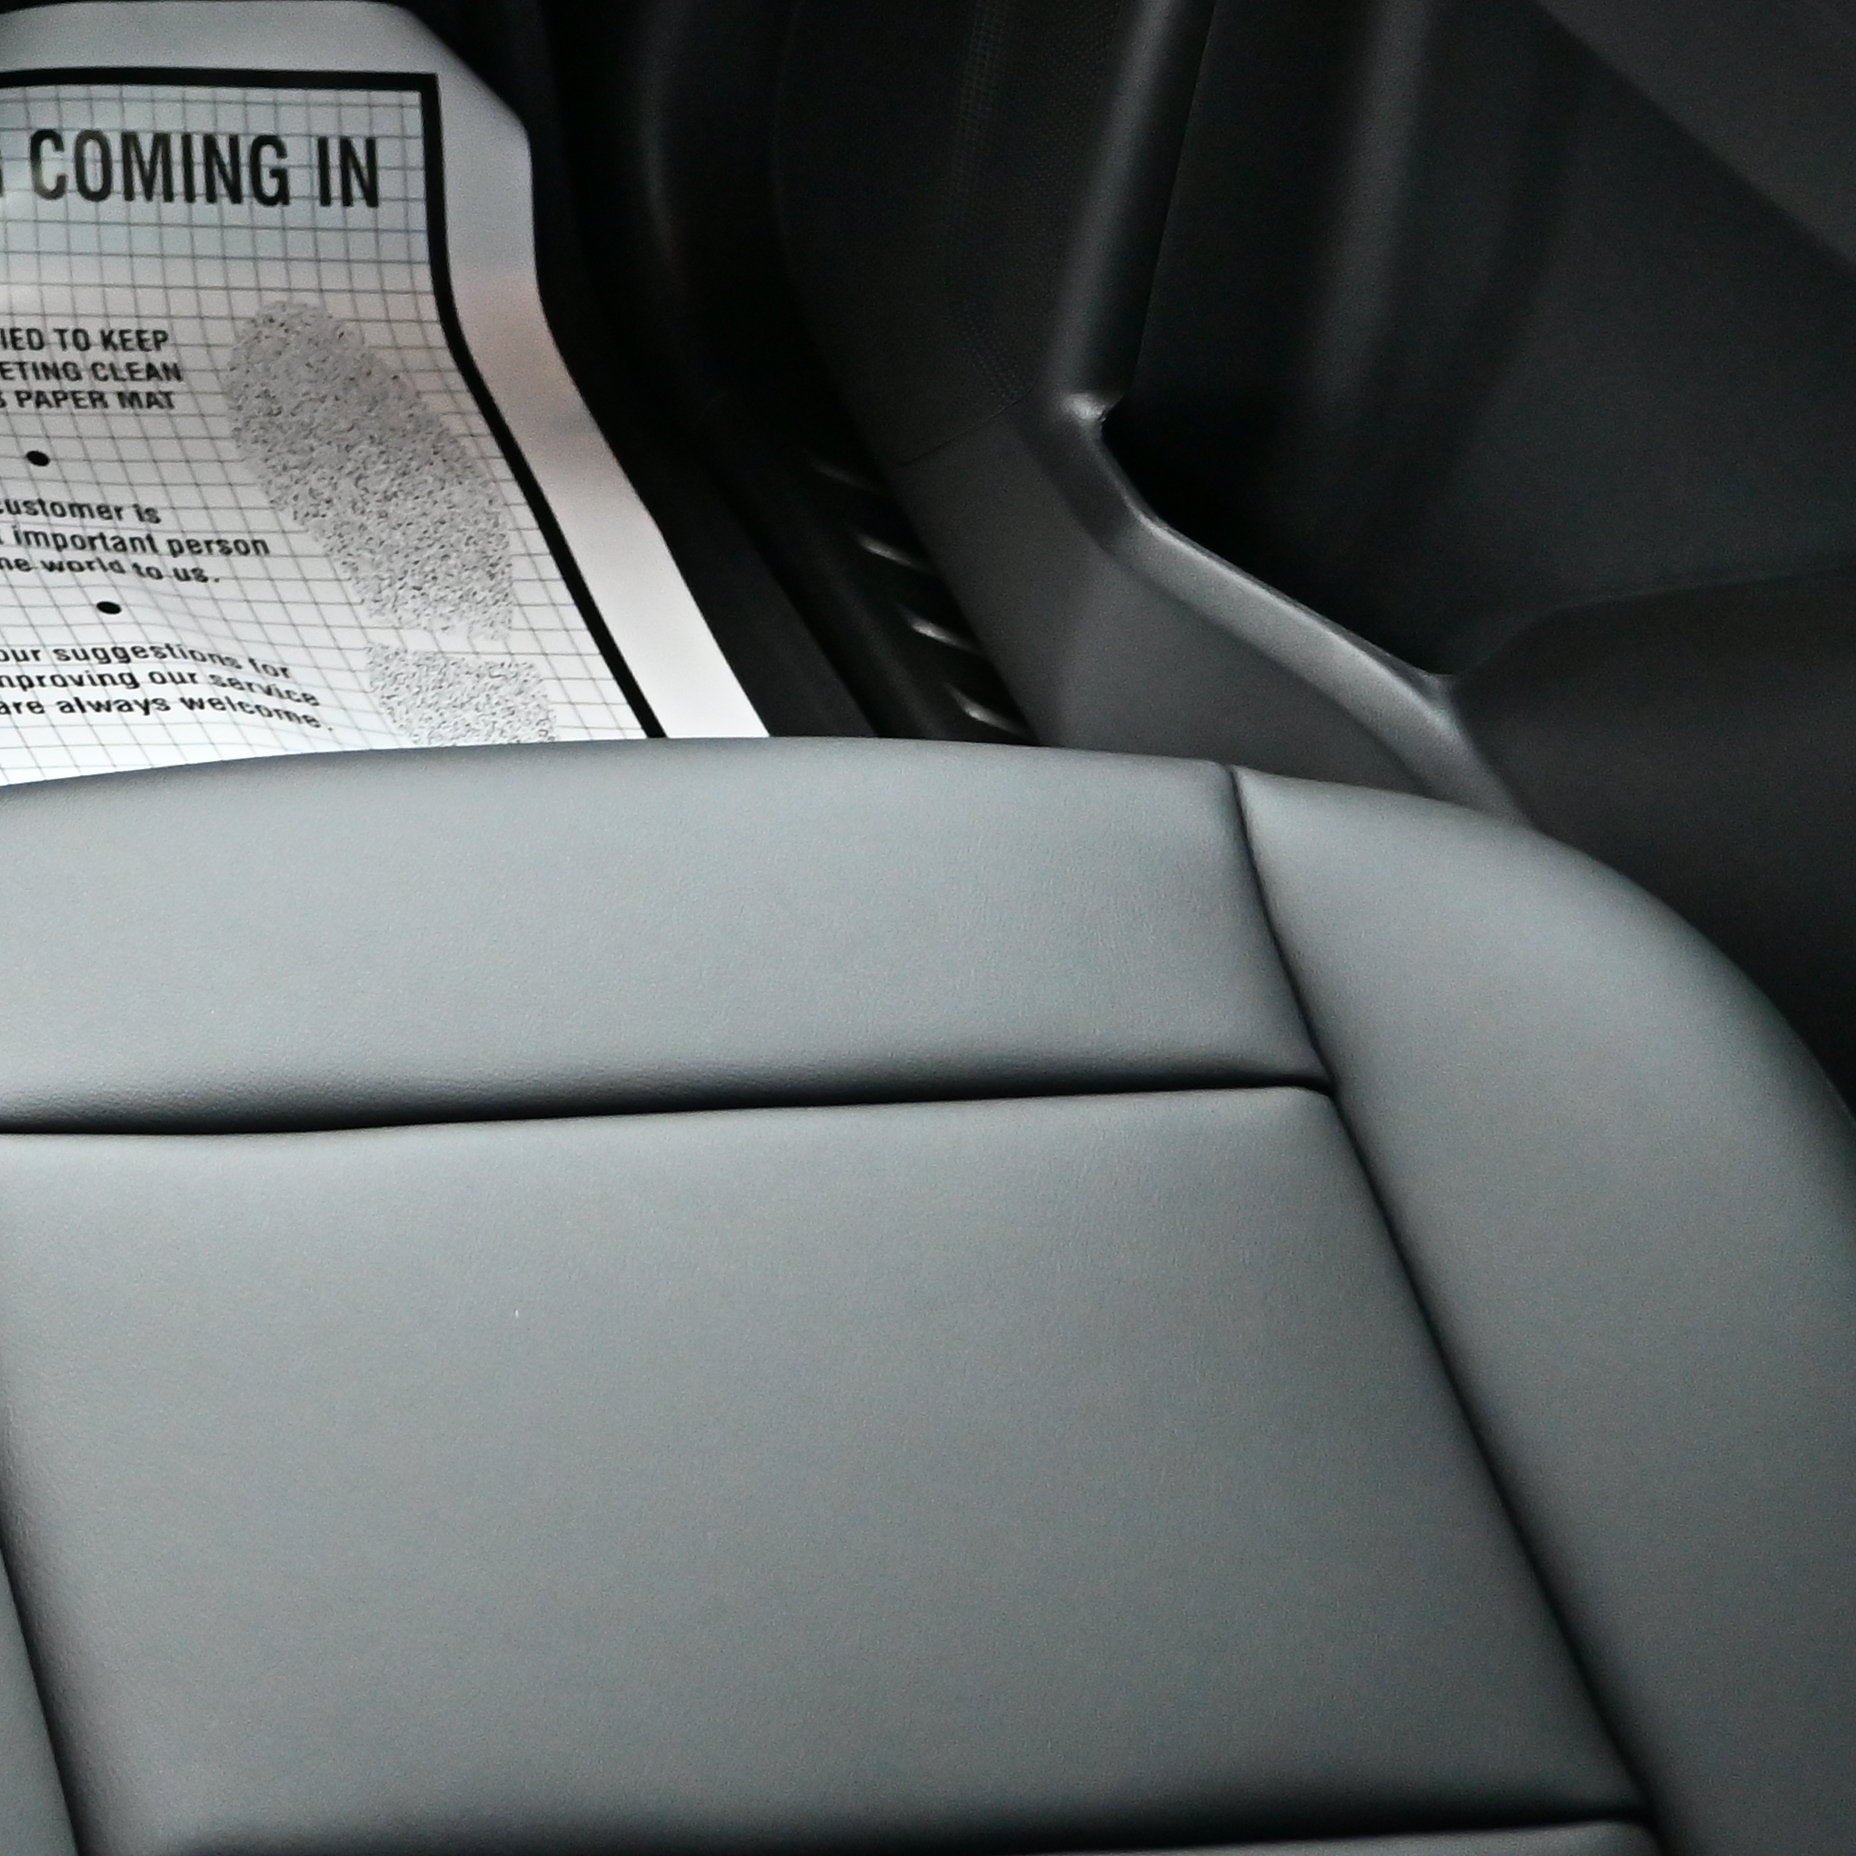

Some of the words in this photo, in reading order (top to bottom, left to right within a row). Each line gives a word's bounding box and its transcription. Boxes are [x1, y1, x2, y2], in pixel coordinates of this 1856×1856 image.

[30, 128, 289, 206] COMING
[318, 136, 379, 208] IN
[53, 329, 88, 351] TO
[101, 329, 169, 352] KEEP
[93, 361, 183, 383] CLEAN
[17, 389, 108, 409] PAPER
[118, 391, 176, 410] MAT
[136, 503, 161, 524] is
[12, 524, 159, 555] important
[167, 537, 270, 558] person
[40, 555, 127, 575] world
[132, 561, 164, 581] to
[173, 566, 221, 584] us.
[53, 643, 239, 670] suggestions
[249, 655, 291, 680] for
[148, 669, 199, 686] our
[210, 673, 320, 707] service
[56, 695, 172, 718] always
[180, 694, 334, 732] welcome.
